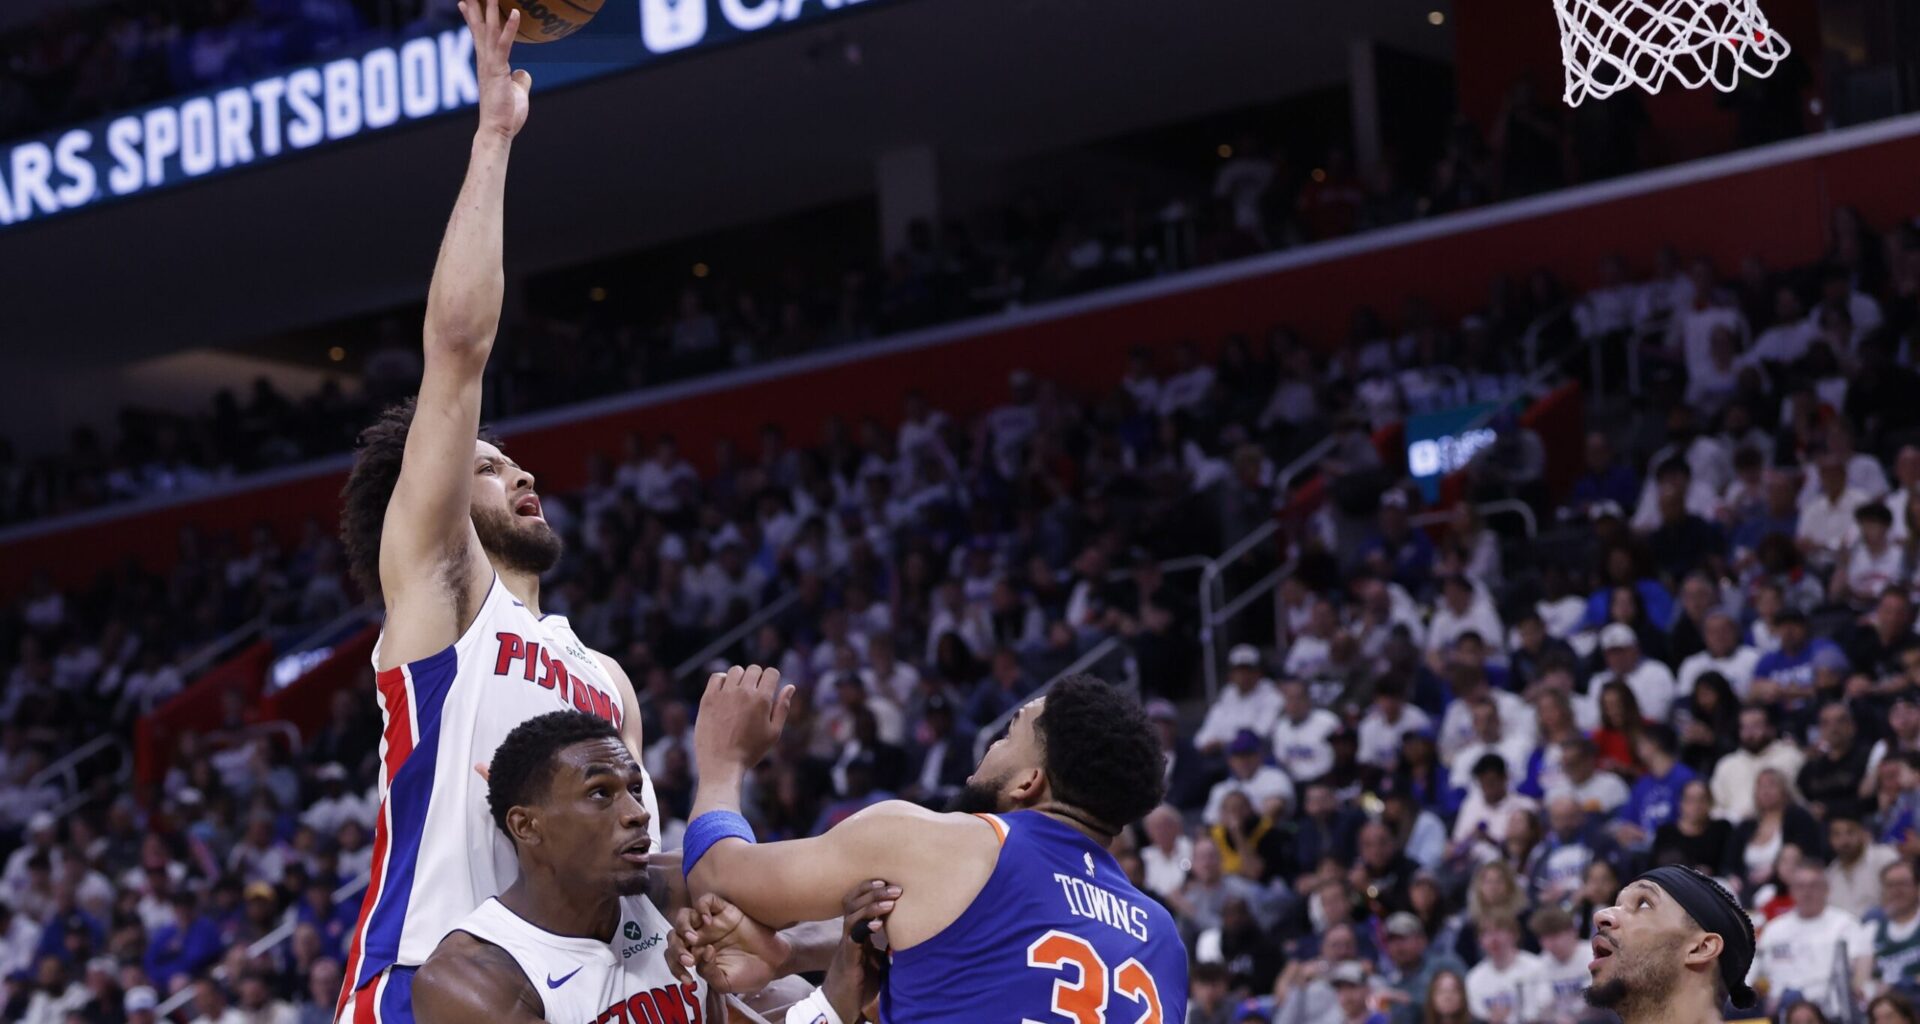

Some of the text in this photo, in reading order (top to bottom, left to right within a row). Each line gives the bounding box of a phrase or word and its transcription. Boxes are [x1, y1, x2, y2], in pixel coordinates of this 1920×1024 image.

[107, 26, 480, 195] SPORTSBOOK
[566, 645, 598, 669] Stoc
[1054, 872, 1148, 942] TOWNS
[622, 933, 663, 959] StockX
[1027, 929, 1164, 1024] 32
